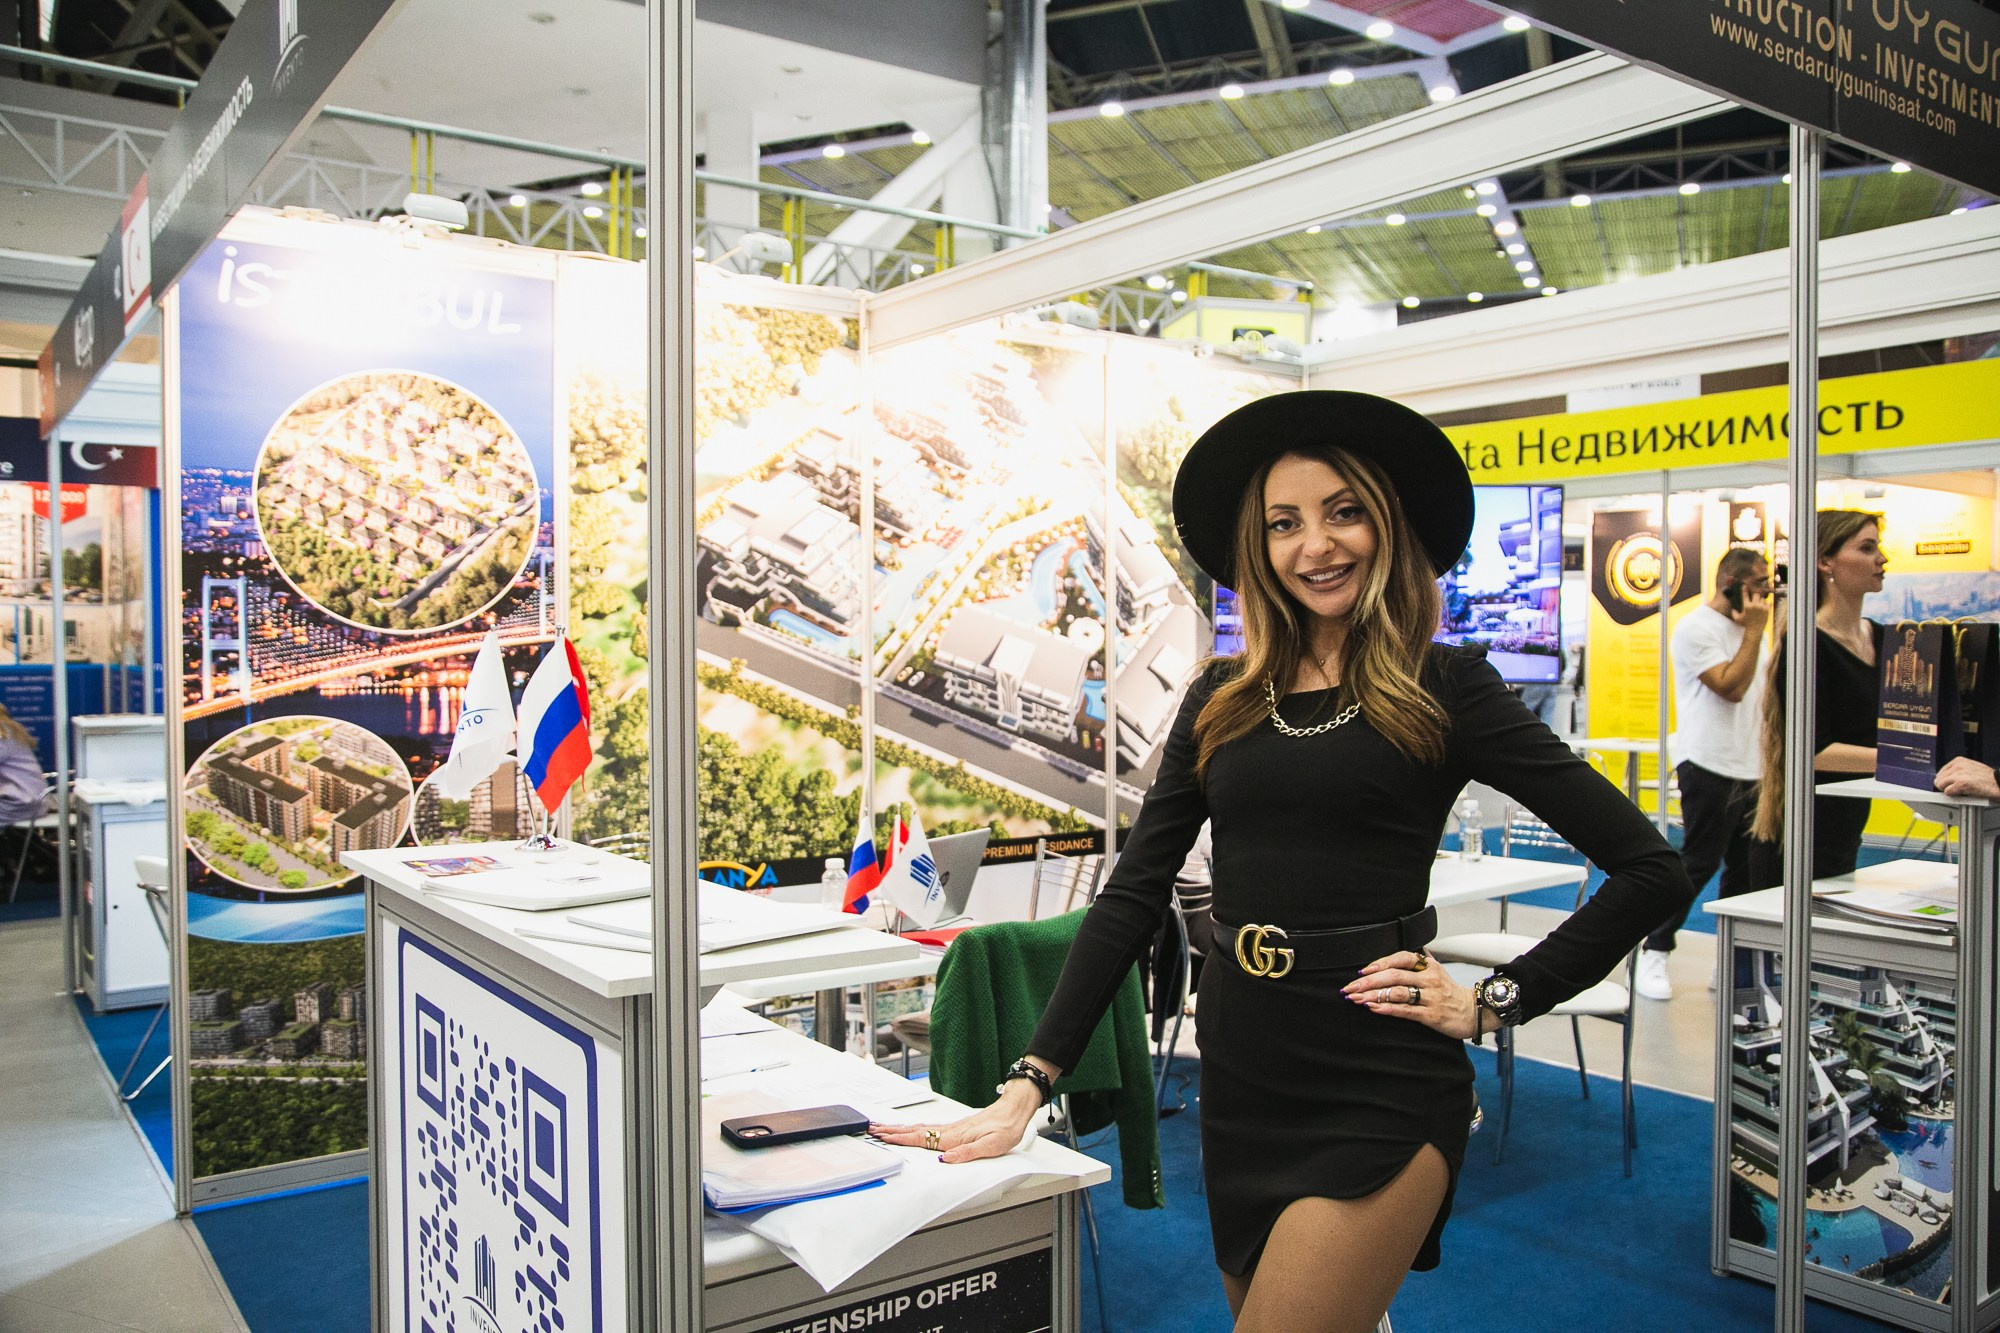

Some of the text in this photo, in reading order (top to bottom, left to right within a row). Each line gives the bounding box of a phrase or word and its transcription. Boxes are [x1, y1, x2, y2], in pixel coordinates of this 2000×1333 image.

[1724, 0, 1852, 61] UCTION
[1710, 13, 1956, 136] www.serdaruyguninsaat.com
[982, 844, 1033, 859] PREMIUM
[776, 1271, 997, 1333] ENSHIP OFFER
